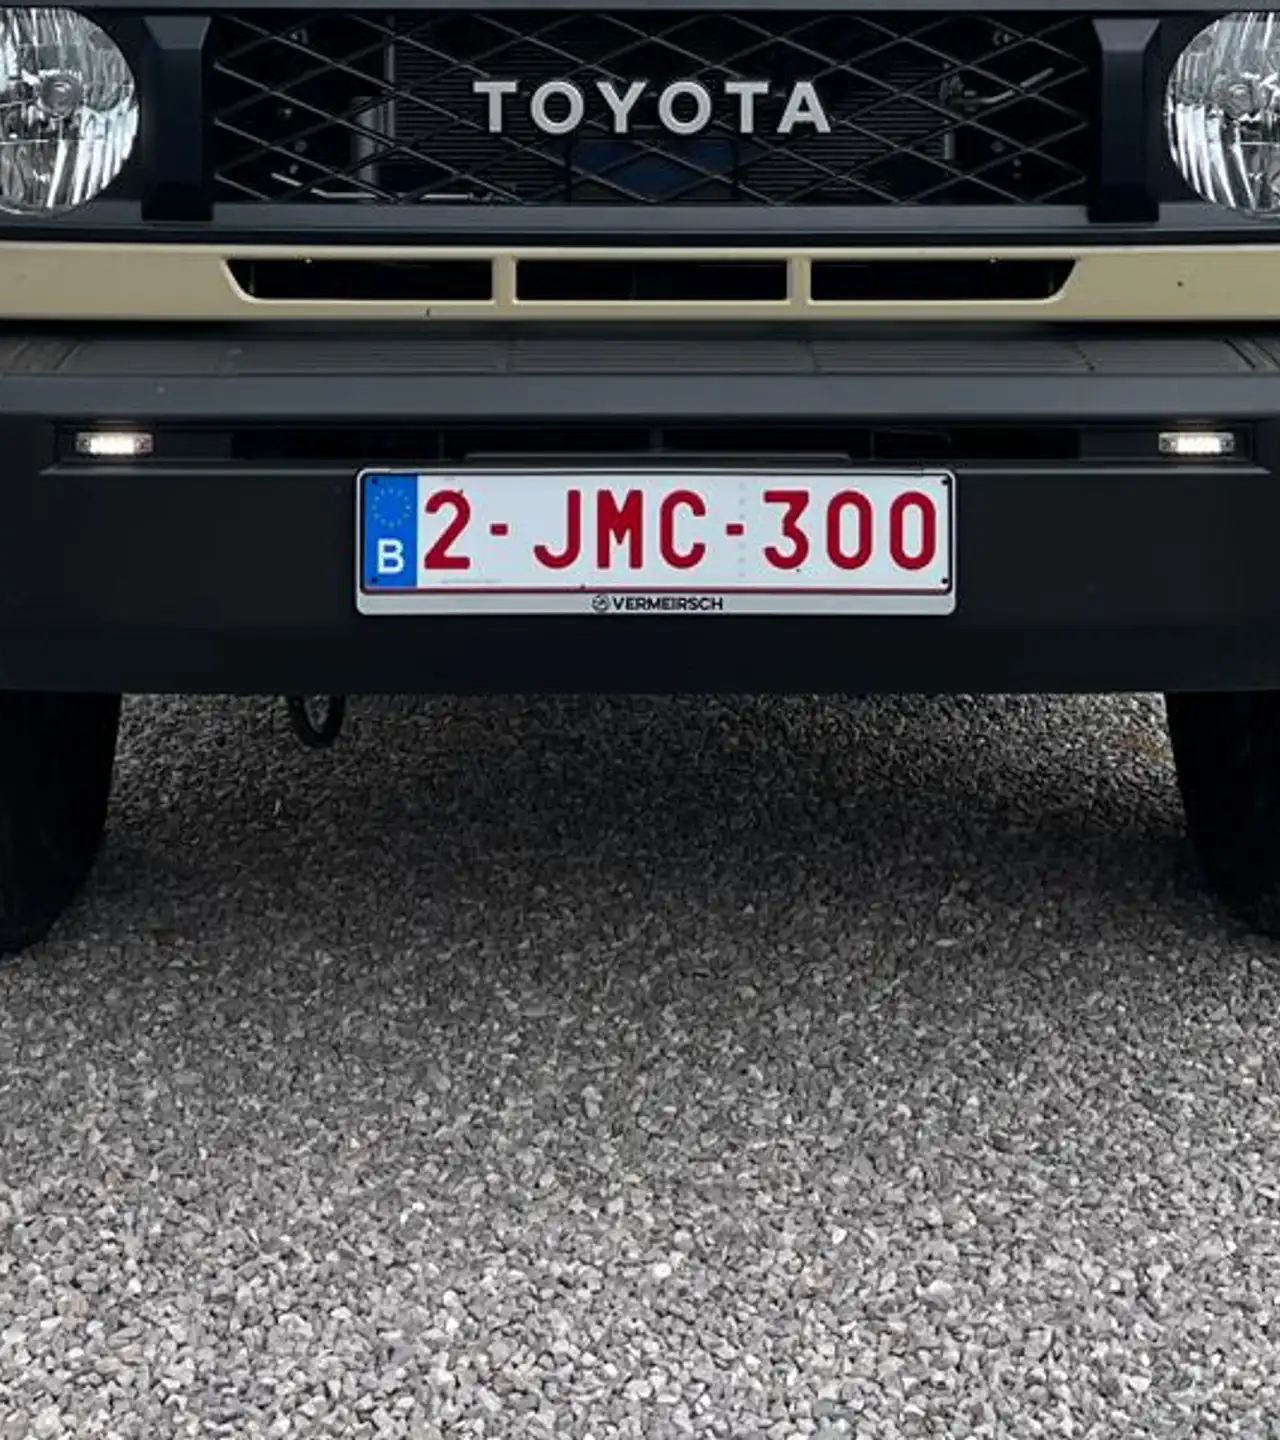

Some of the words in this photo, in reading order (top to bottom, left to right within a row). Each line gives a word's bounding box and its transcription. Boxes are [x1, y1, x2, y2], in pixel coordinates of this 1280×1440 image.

[473, 80, 831, 135] TOYOTA
[377, 539, 404, 573] B
[613, 595, 724, 611] VERMEIRSCH
